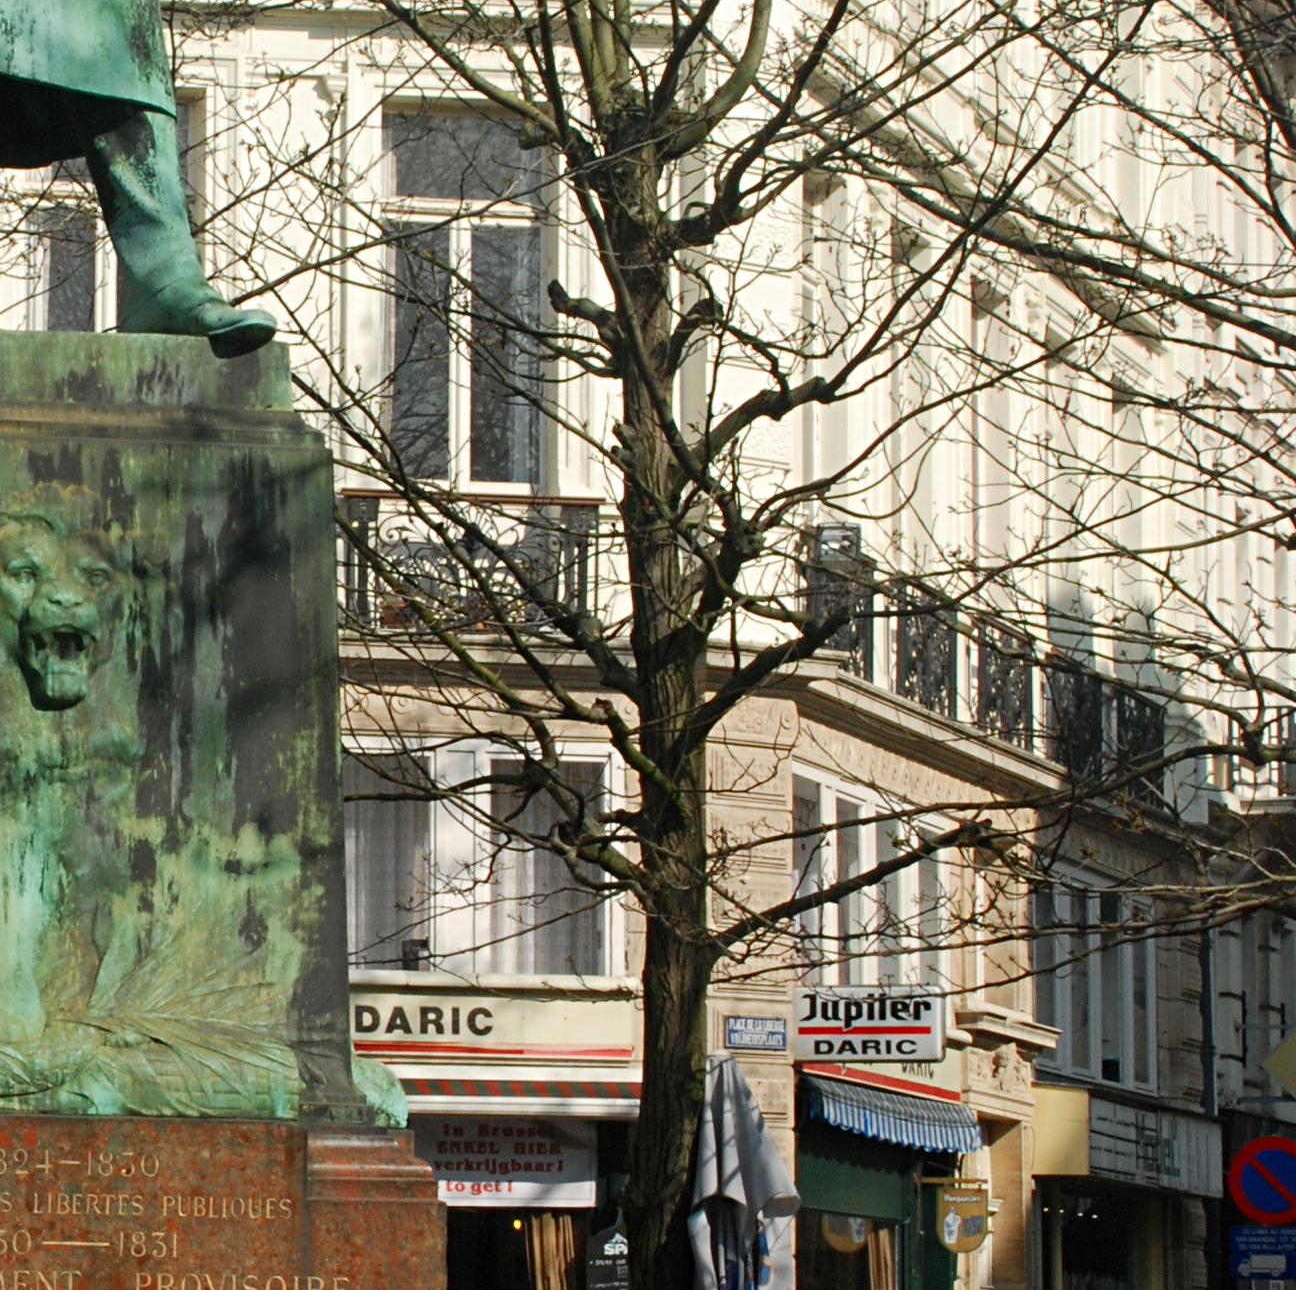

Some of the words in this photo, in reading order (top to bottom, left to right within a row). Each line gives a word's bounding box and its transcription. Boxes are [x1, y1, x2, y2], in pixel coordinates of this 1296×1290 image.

[800, 994, 932, 1030] Jupiler
[354, 1005, 494, 1036] DARIC
[814, 1040, 918, 1055] DARIC
[443, 1124, 464, 1137] In
[436, 1141, 500, 1154] ENKEL
[514, 1142, 563, 1155] HIER
[446, 1181, 465, 1192] to
[33, 1193, 144, 1216] LIBERTES
[162, 1195, 292, 1219] PUBLIQUES
